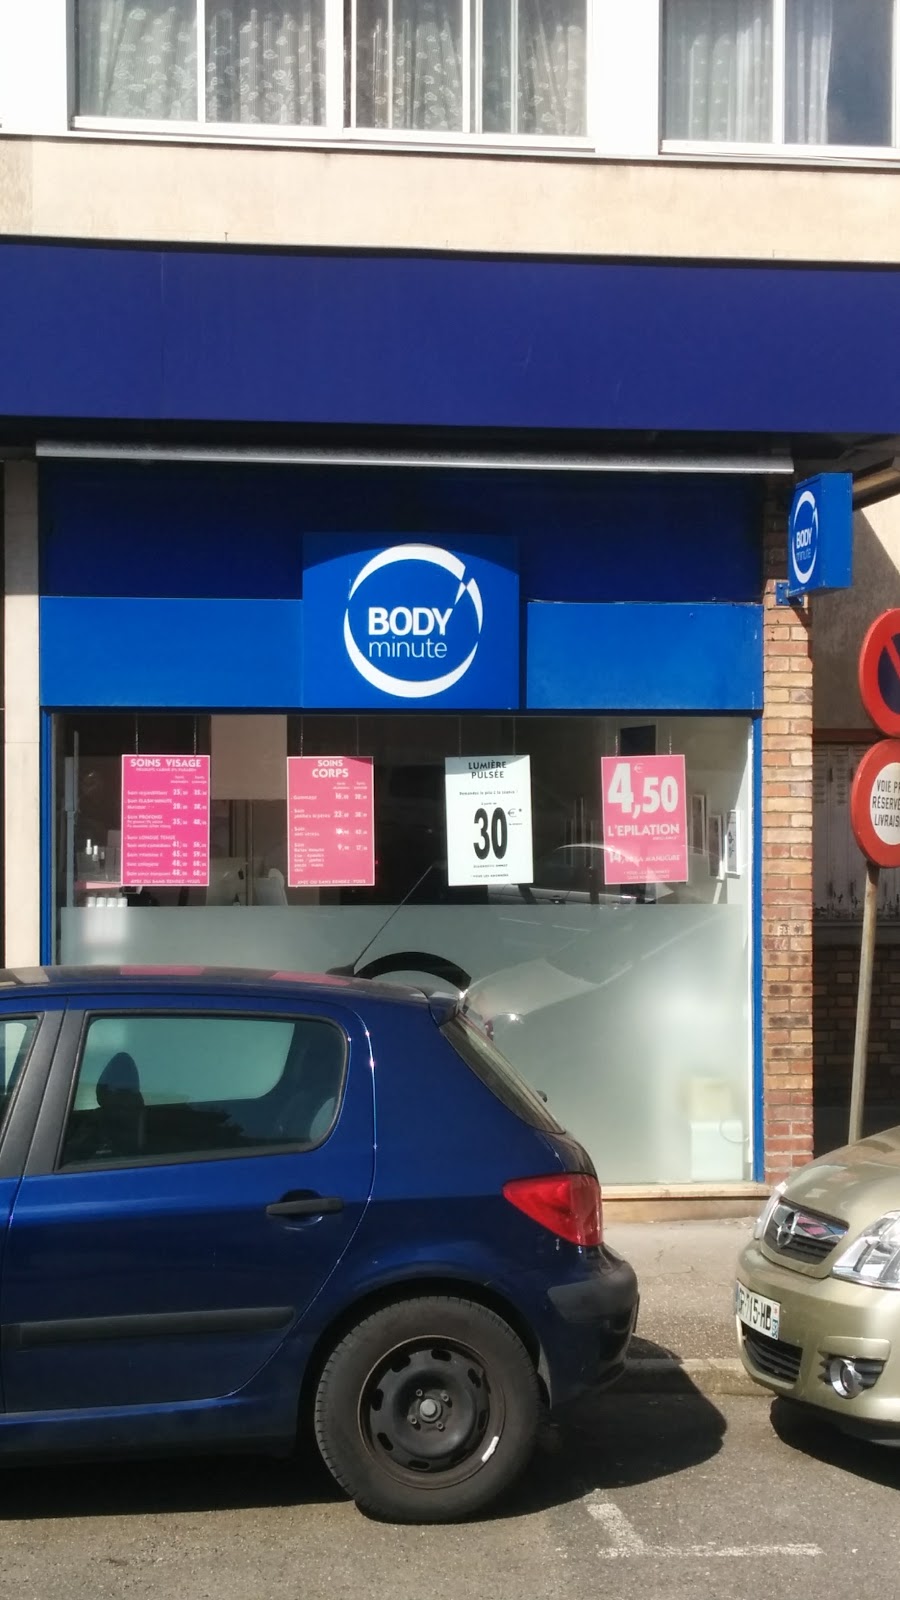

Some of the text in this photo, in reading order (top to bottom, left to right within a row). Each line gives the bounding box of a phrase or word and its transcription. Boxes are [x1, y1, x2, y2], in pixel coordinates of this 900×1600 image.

[796, 527, 812, 549] BODY
[368, 606, 453, 636] BODY
[369, 636, 448, 658] minute
[130, 758, 201, 768] SOINS VISAGE
[317, 759, 343, 767] SOINS
[468, 760, 507, 770] LUMIÈRE
[312, 768, 349, 778] CORPS
[471, 770, 505, 779] PULSÉE
[607, 762, 679, 820] 4,50
[877, 780, 892, 793] VOIE
[473, 807, 508, 860] 30
[608, 823, 680, 837] L'EPILATION
